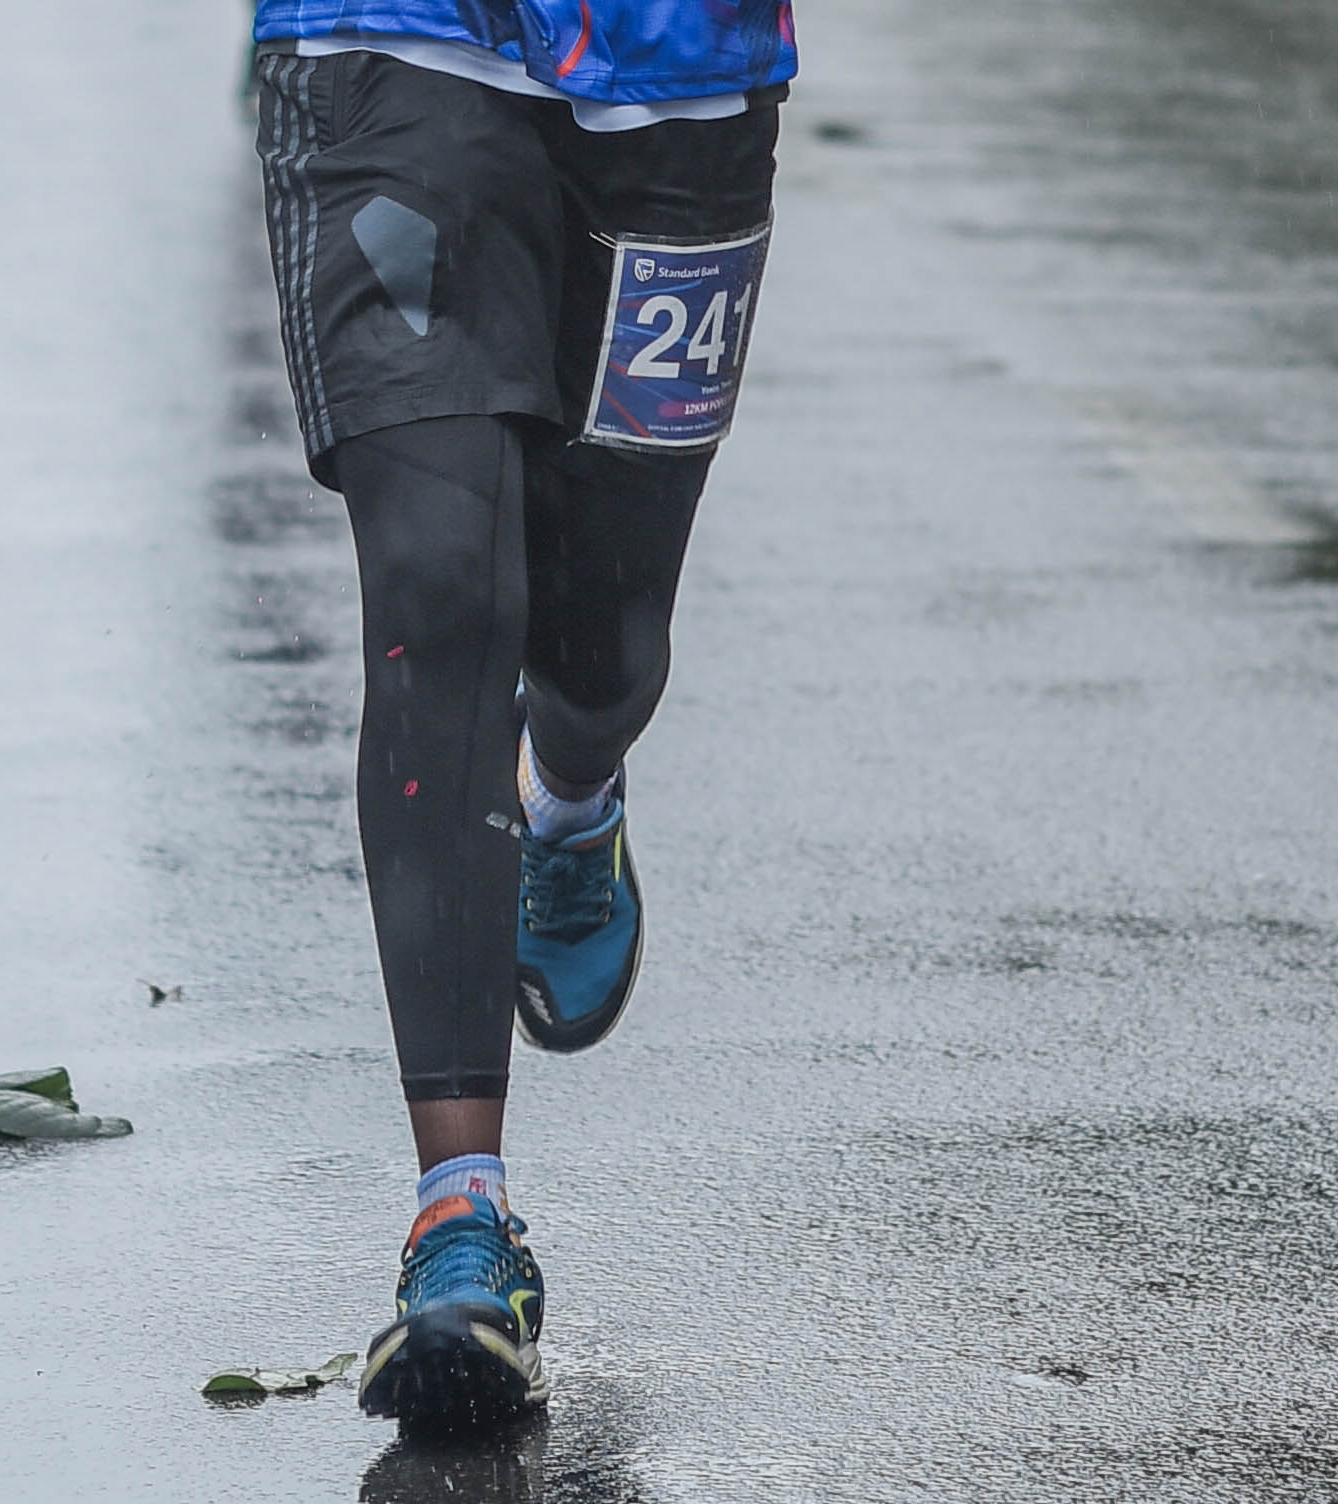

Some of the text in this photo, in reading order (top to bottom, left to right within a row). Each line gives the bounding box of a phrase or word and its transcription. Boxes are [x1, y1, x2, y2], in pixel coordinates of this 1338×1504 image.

[658, 265, 719, 278] Standard Bank
[627, 282, 752, 379] 241
[685, 401, 710, 416] 12KM
